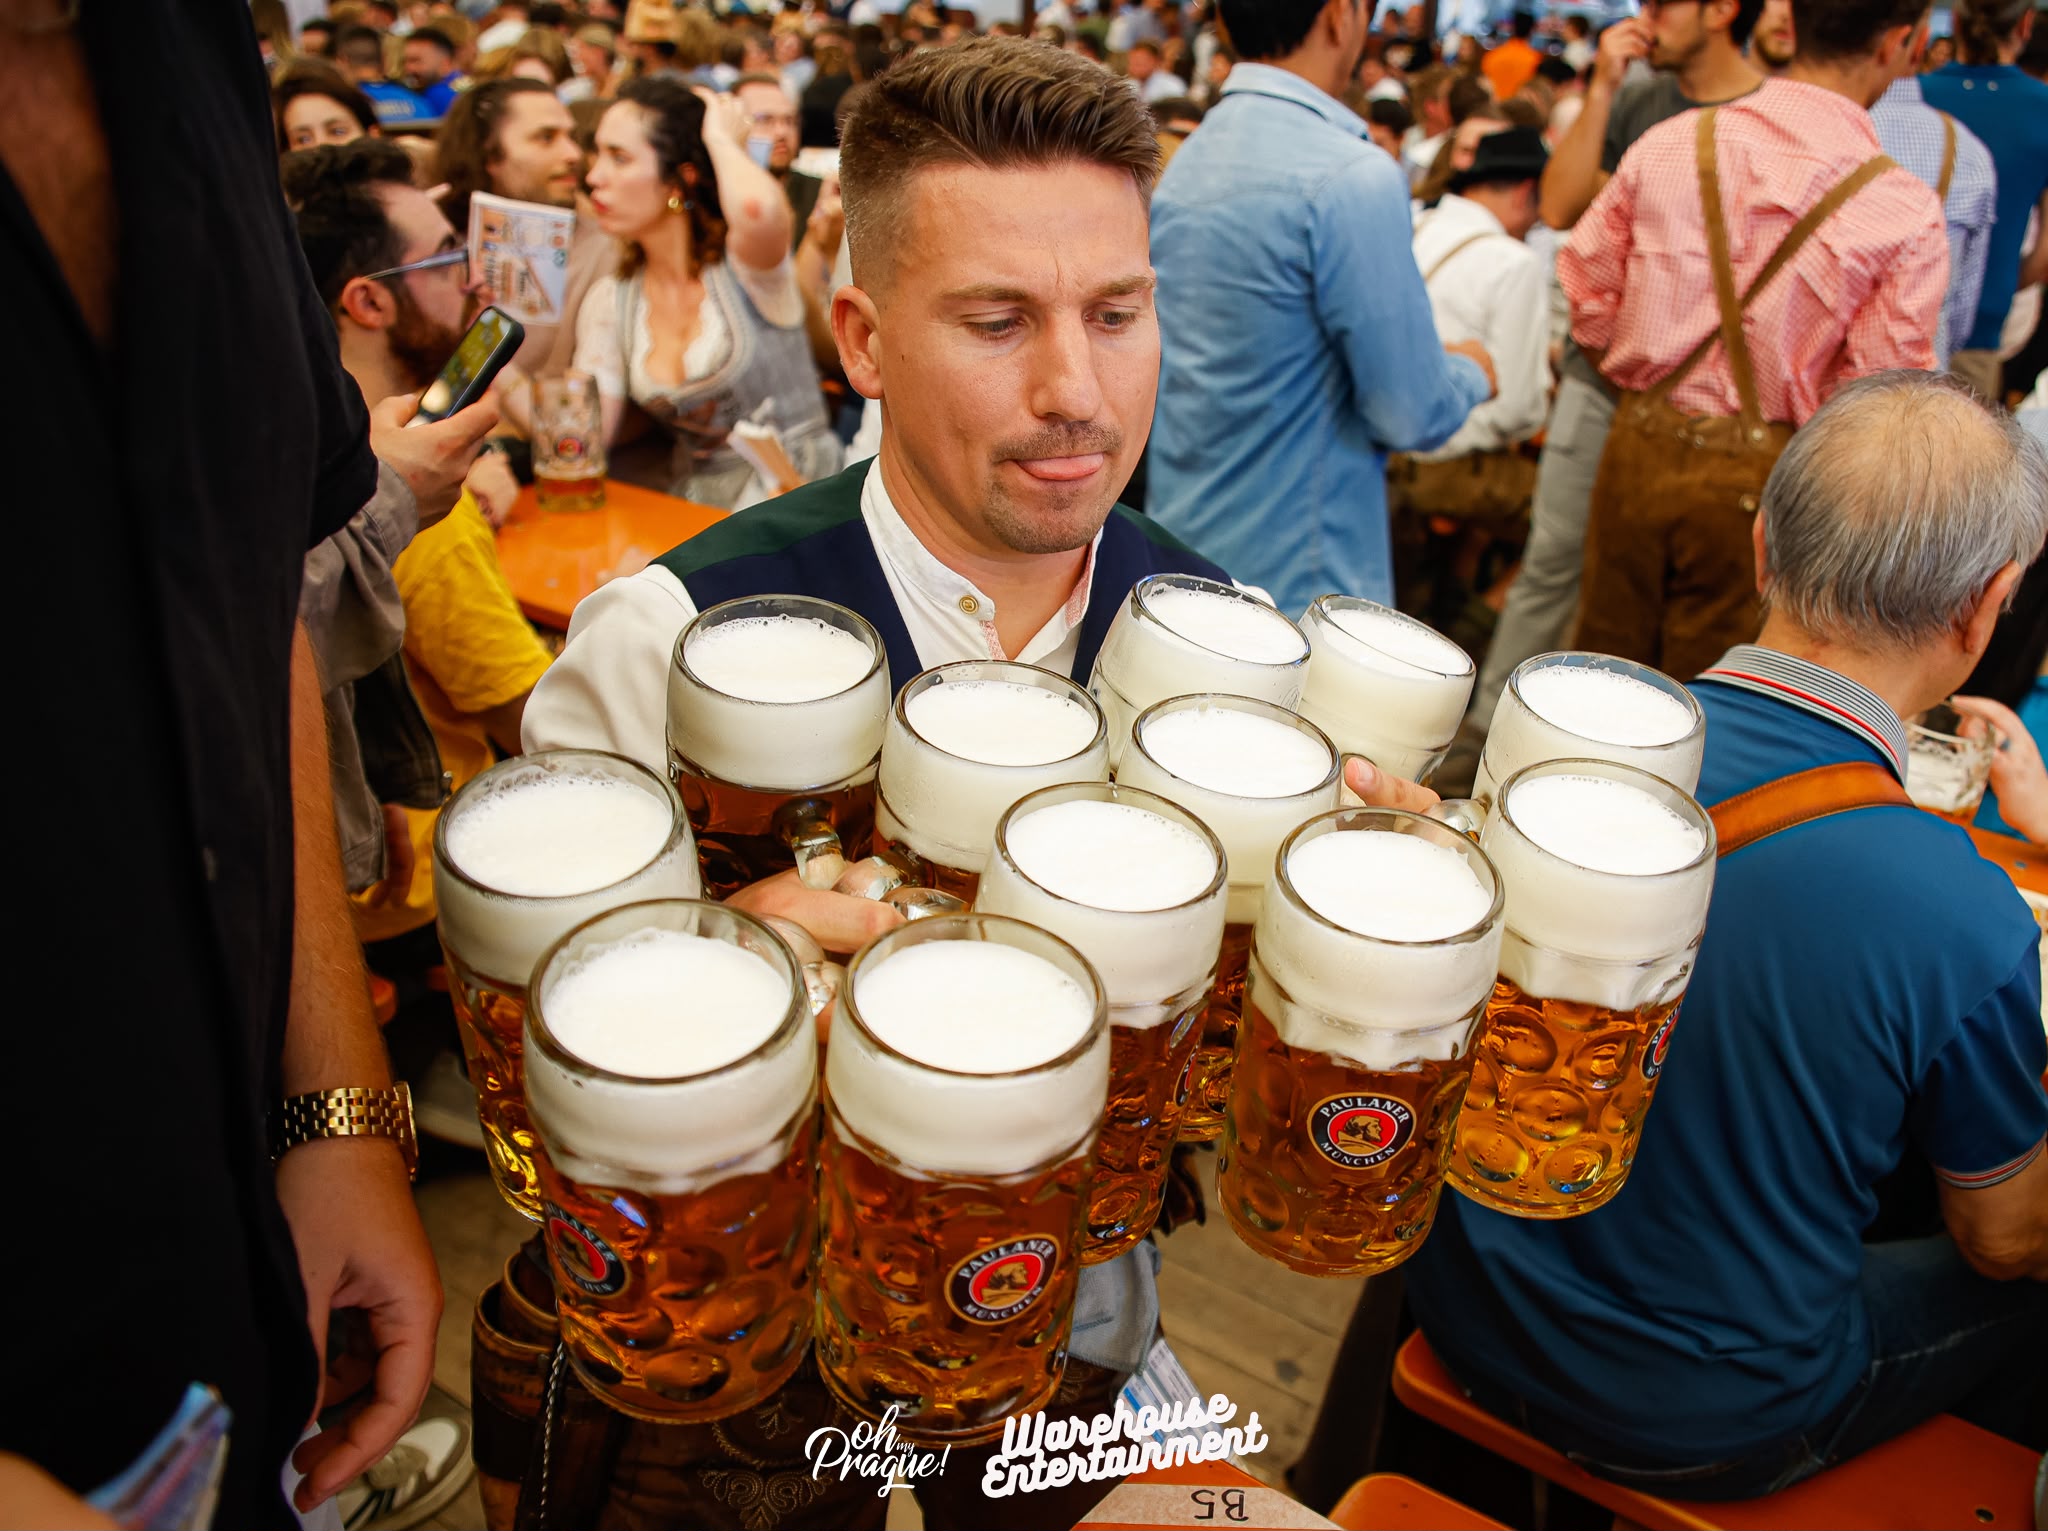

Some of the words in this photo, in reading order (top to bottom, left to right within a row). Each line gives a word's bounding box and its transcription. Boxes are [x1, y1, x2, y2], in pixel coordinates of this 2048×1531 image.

[1319, 1097, 1410, 1123] PAULANER
[957, 1239, 1055, 1279] PAULANER
[1190, 1489, 1249, 1522] B5
